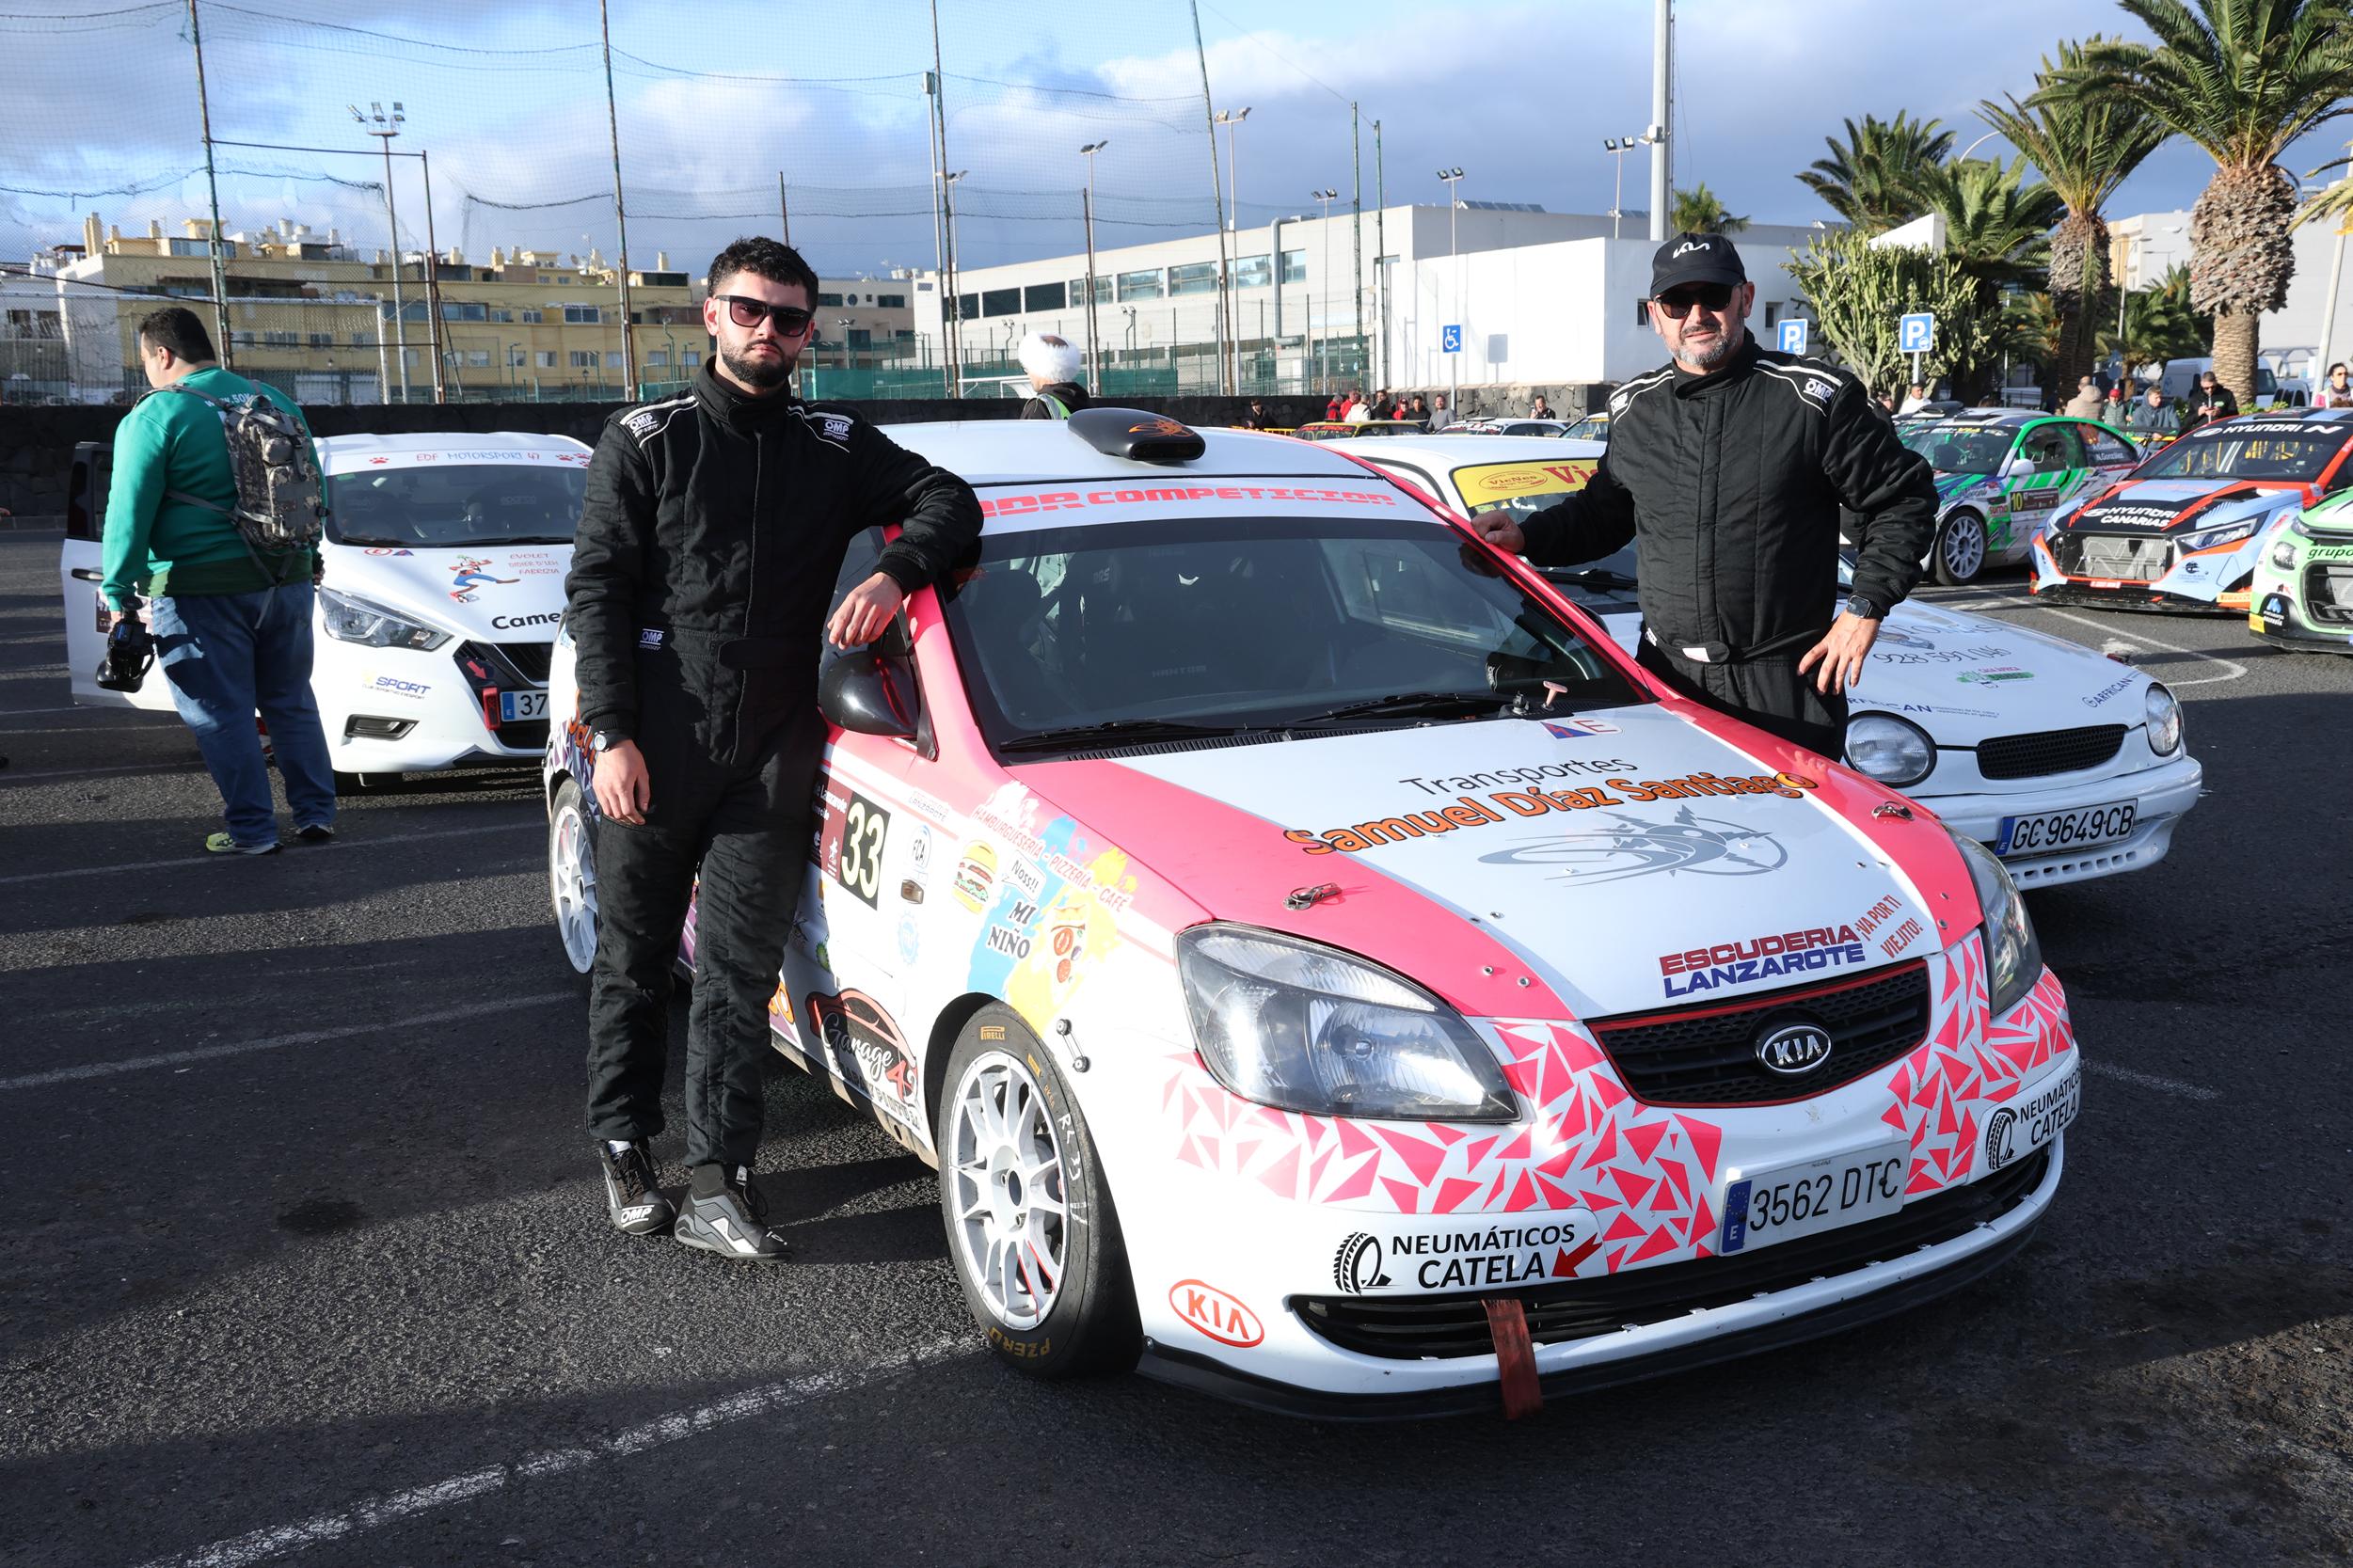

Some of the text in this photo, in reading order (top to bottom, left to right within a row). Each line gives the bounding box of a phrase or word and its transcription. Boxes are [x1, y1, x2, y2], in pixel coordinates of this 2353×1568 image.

[1805, 380, 1832, 399] OMP
[629, 414, 653, 430] OMP
[825, 421, 849, 434] OMP
[2223, 424, 2303, 434] HYUNDAI
[447, 451, 522, 460] MOTORSPORT
[1542, 466, 1598, 485] Vi
[2011, 492, 2023, 511] 10
[2107, 507, 2180, 518] HYUNDAI
[2101, 515, 2170, 527] CANARIAS
[642, 631, 662, 642] OMP
[1873, 653, 1929, 664] 928
[1926, 650, 1979, 663] 591
[376, 676, 432, 695] SPORT
[1398, 756, 1638, 797] Transportes
[1283, 771, 1820, 854] Samuel Díaz Santiago
[841, 801, 884, 898] 33
[1099, 888, 1130, 912] CAFÉ
[1009, 902, 1037, 925] MI
[1854, 895, 1901, 942] ¡VA POR TI
[988, 927, 1030, 958] NIÑO
[1881, 918, 1923, 958] VIEJITO!
[1660, 925, 1861, 976] ESCUDERIA
[1664, 942, 1866, 998] LANZAROTE
[980, 1026, 1005, 1040] PIRELLI
[823, 1012, 894, 1082] Garage
[1773, 1035, 1823, 1067] KIA
[2030, 1092, 2076, 1145] CATELA
[1750, 1158, 1901, 1231] 3562 DTC
[621, 1207, 652, 1223] OMP
[1392, 1223, 1575, 1256] NEUMÁTICOS
[1729, 1226, 1739, 1240] E
[1418, 1251, 1546, 1290] CATELA
[1186, 1288, 1250, 1339] KIA
